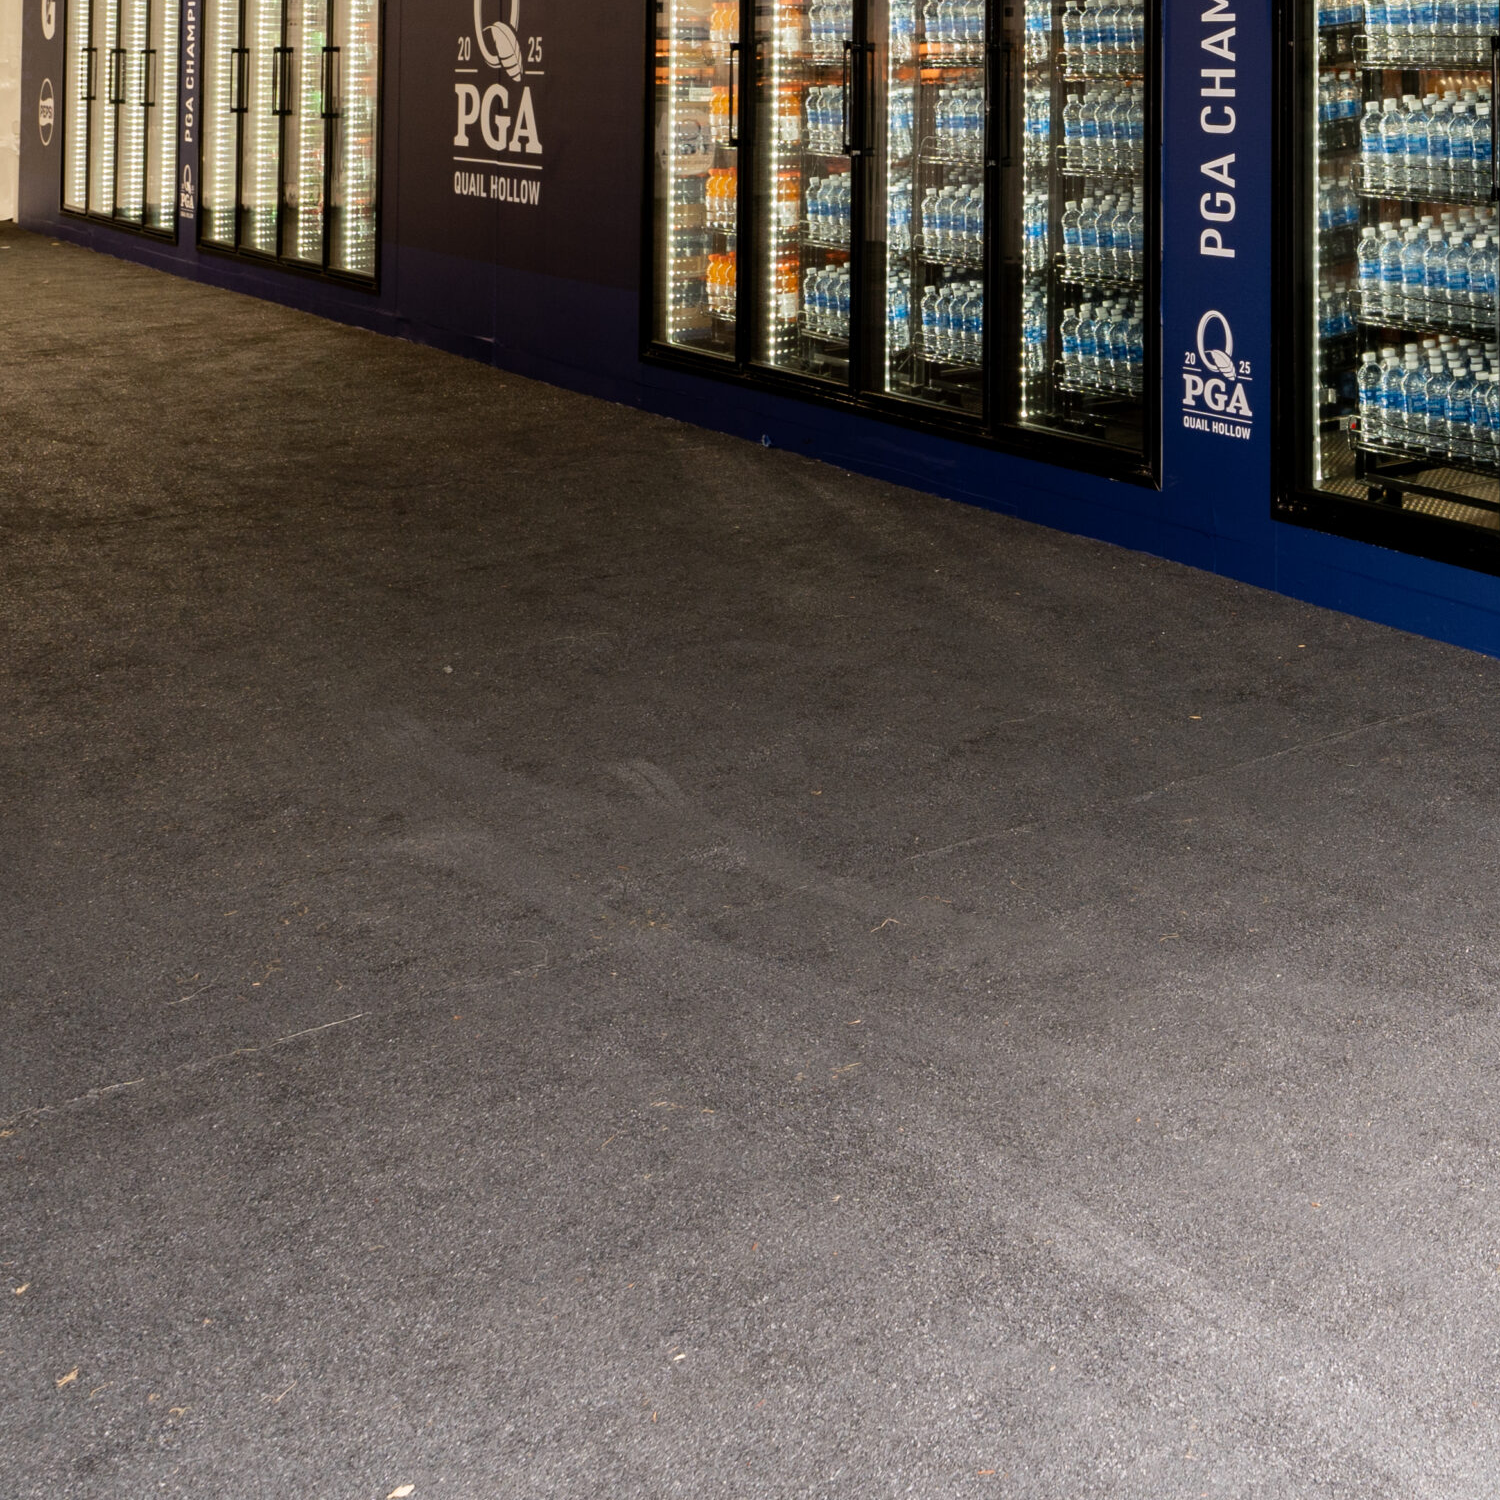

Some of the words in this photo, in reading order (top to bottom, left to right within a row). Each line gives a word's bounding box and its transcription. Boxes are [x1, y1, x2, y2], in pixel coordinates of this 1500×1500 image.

[457, 37, 471, 61] 20
[528, 37, 543, 62] 25
[184, 97, 194, 143] PGA
[454, 83, 543, 154] PGA
[454, 171, 487, 199] QUAIL
[490, 175, 540, 205] HOLLOW
[1200, 153, 1236, 258] PGA
[1184, 352, 1196, 365] 20
[1239, 360, 1251, 374] 25
[1182, 373, 1253, 417] PGA
[1183, 415, 1210, 432] QUAIL
[1212, 421, 1251, 440] HOLLOW
